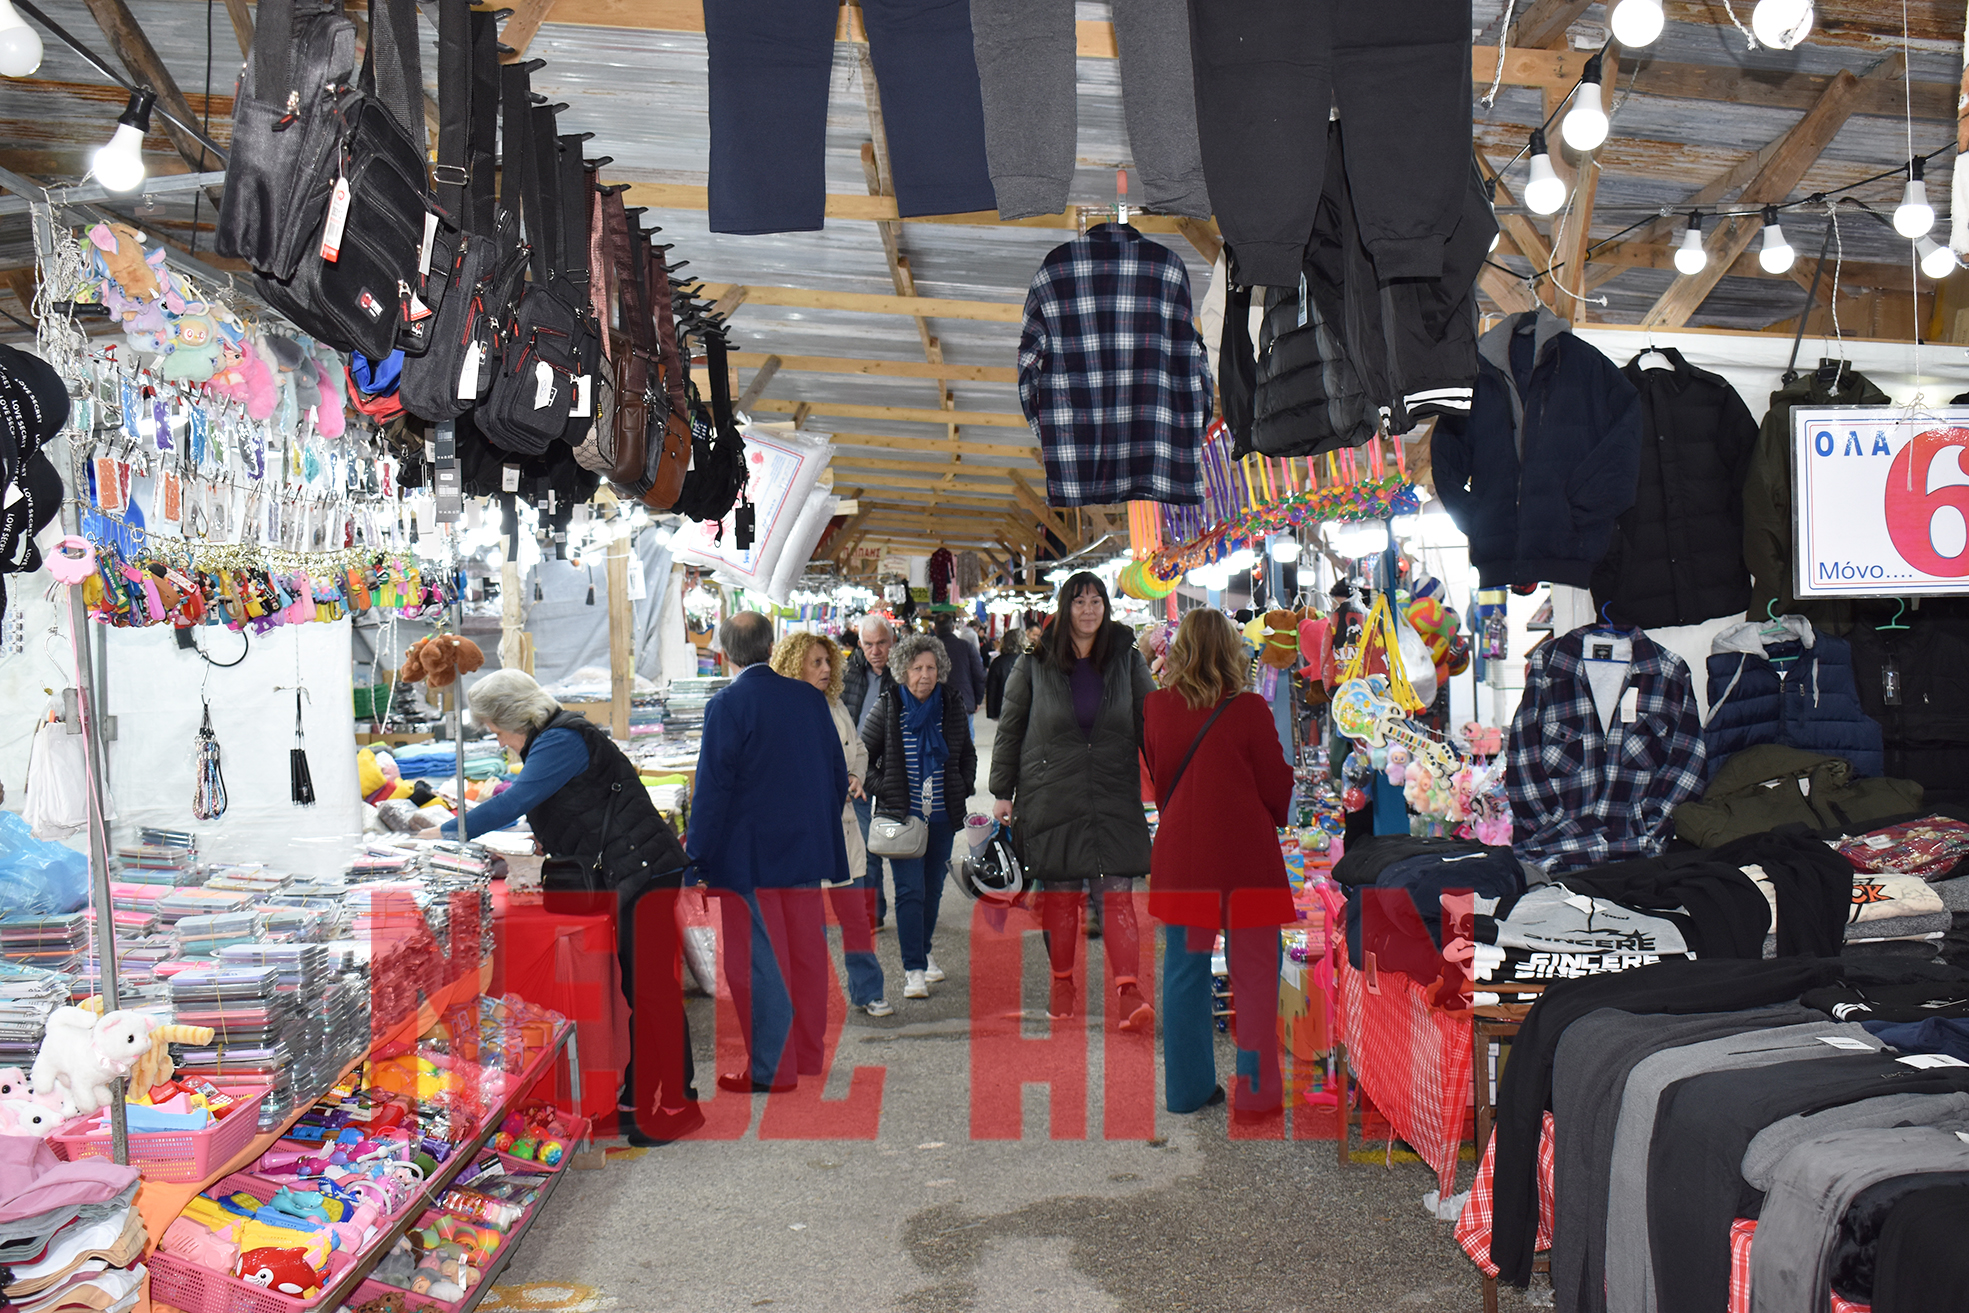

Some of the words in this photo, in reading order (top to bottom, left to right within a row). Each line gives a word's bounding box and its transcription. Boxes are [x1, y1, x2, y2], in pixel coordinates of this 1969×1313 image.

[11, 399, 23, 420] LOVE
[29, 393, 42, 423] SECRET
[1815, 430, 1891, 457] ΟΛΑ
[23, 487, 34, 508] LOVE
[1884, 426, 1969, 578] 6
[3, 513, 15, 533] LOVE
[1851, 884, 1896, 904] CK
[1523, 932, 1656, 951] SINCERE
[1530, 952, 1661, 970] SINCERE
